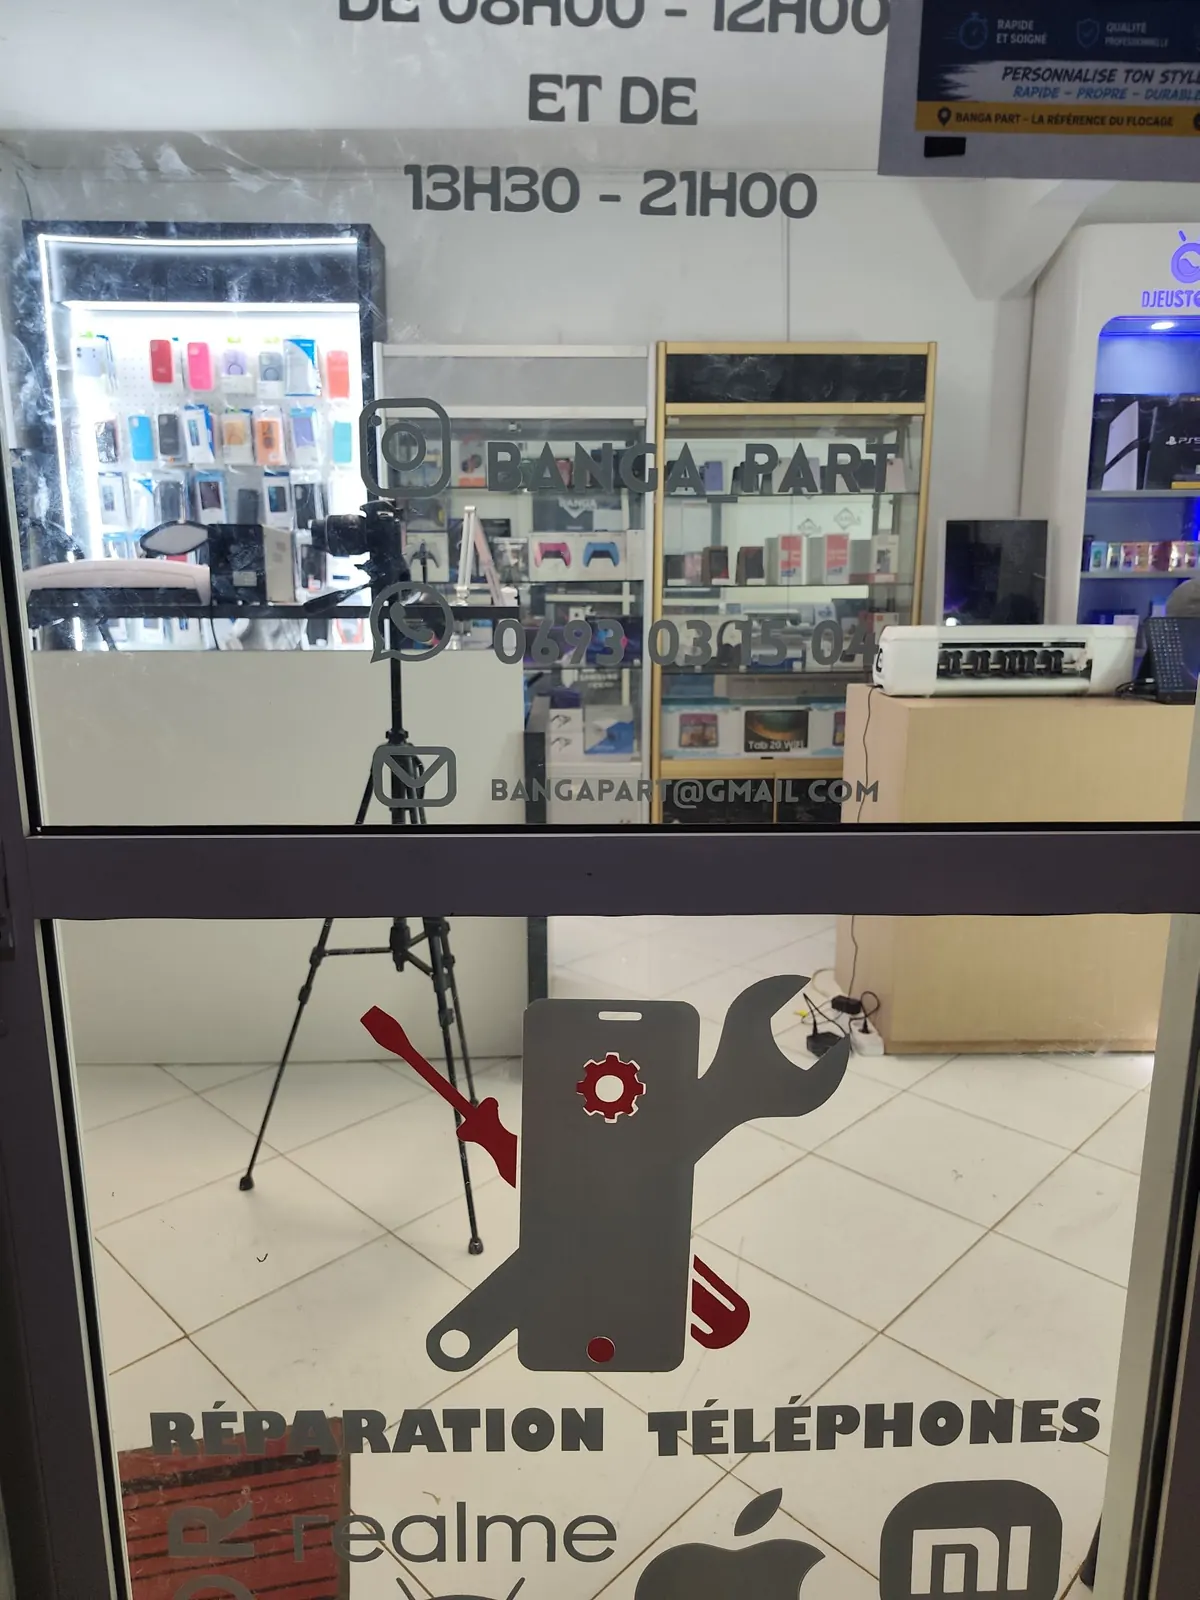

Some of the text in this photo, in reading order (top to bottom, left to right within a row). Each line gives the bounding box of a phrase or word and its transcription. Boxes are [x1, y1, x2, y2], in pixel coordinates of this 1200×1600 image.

[996, 32, 1047, 45] ET SOIGNÉ
[997, 19, 1034, 31] RAPIDE
[1002, 66, 1118, 83] PERSONNALISE
[1124, 68, 1155, 84] TON
[529, 74, 697, 125] ET DE
[1013, 86, 1061, 99] RAPIDE
[1076, 87, 1129, 100] PROPRE
[955, 112, 992, 123] BANGA
[994, 113, 1021, 124] PART
[1031, 114, 1044, 125] LA
[1046, 112, 1106, 126] RÉFÉRENCE
[1109, 115, 1124, 126] DU
[1126, 115, 1173, 127] FLOCAGE
[404, 164, 817, 219] 13H30 - 21H00
[487, 442, 900, 494] BANGA PART
[494, 618, 879, 667] 0693 03 15 04
[748, 740, 768, 750] Tab
[150, 1395, 1101, 1457] RÉPARATION TÉLÉPHONES
[293, 1502, 617, 1563] realme
